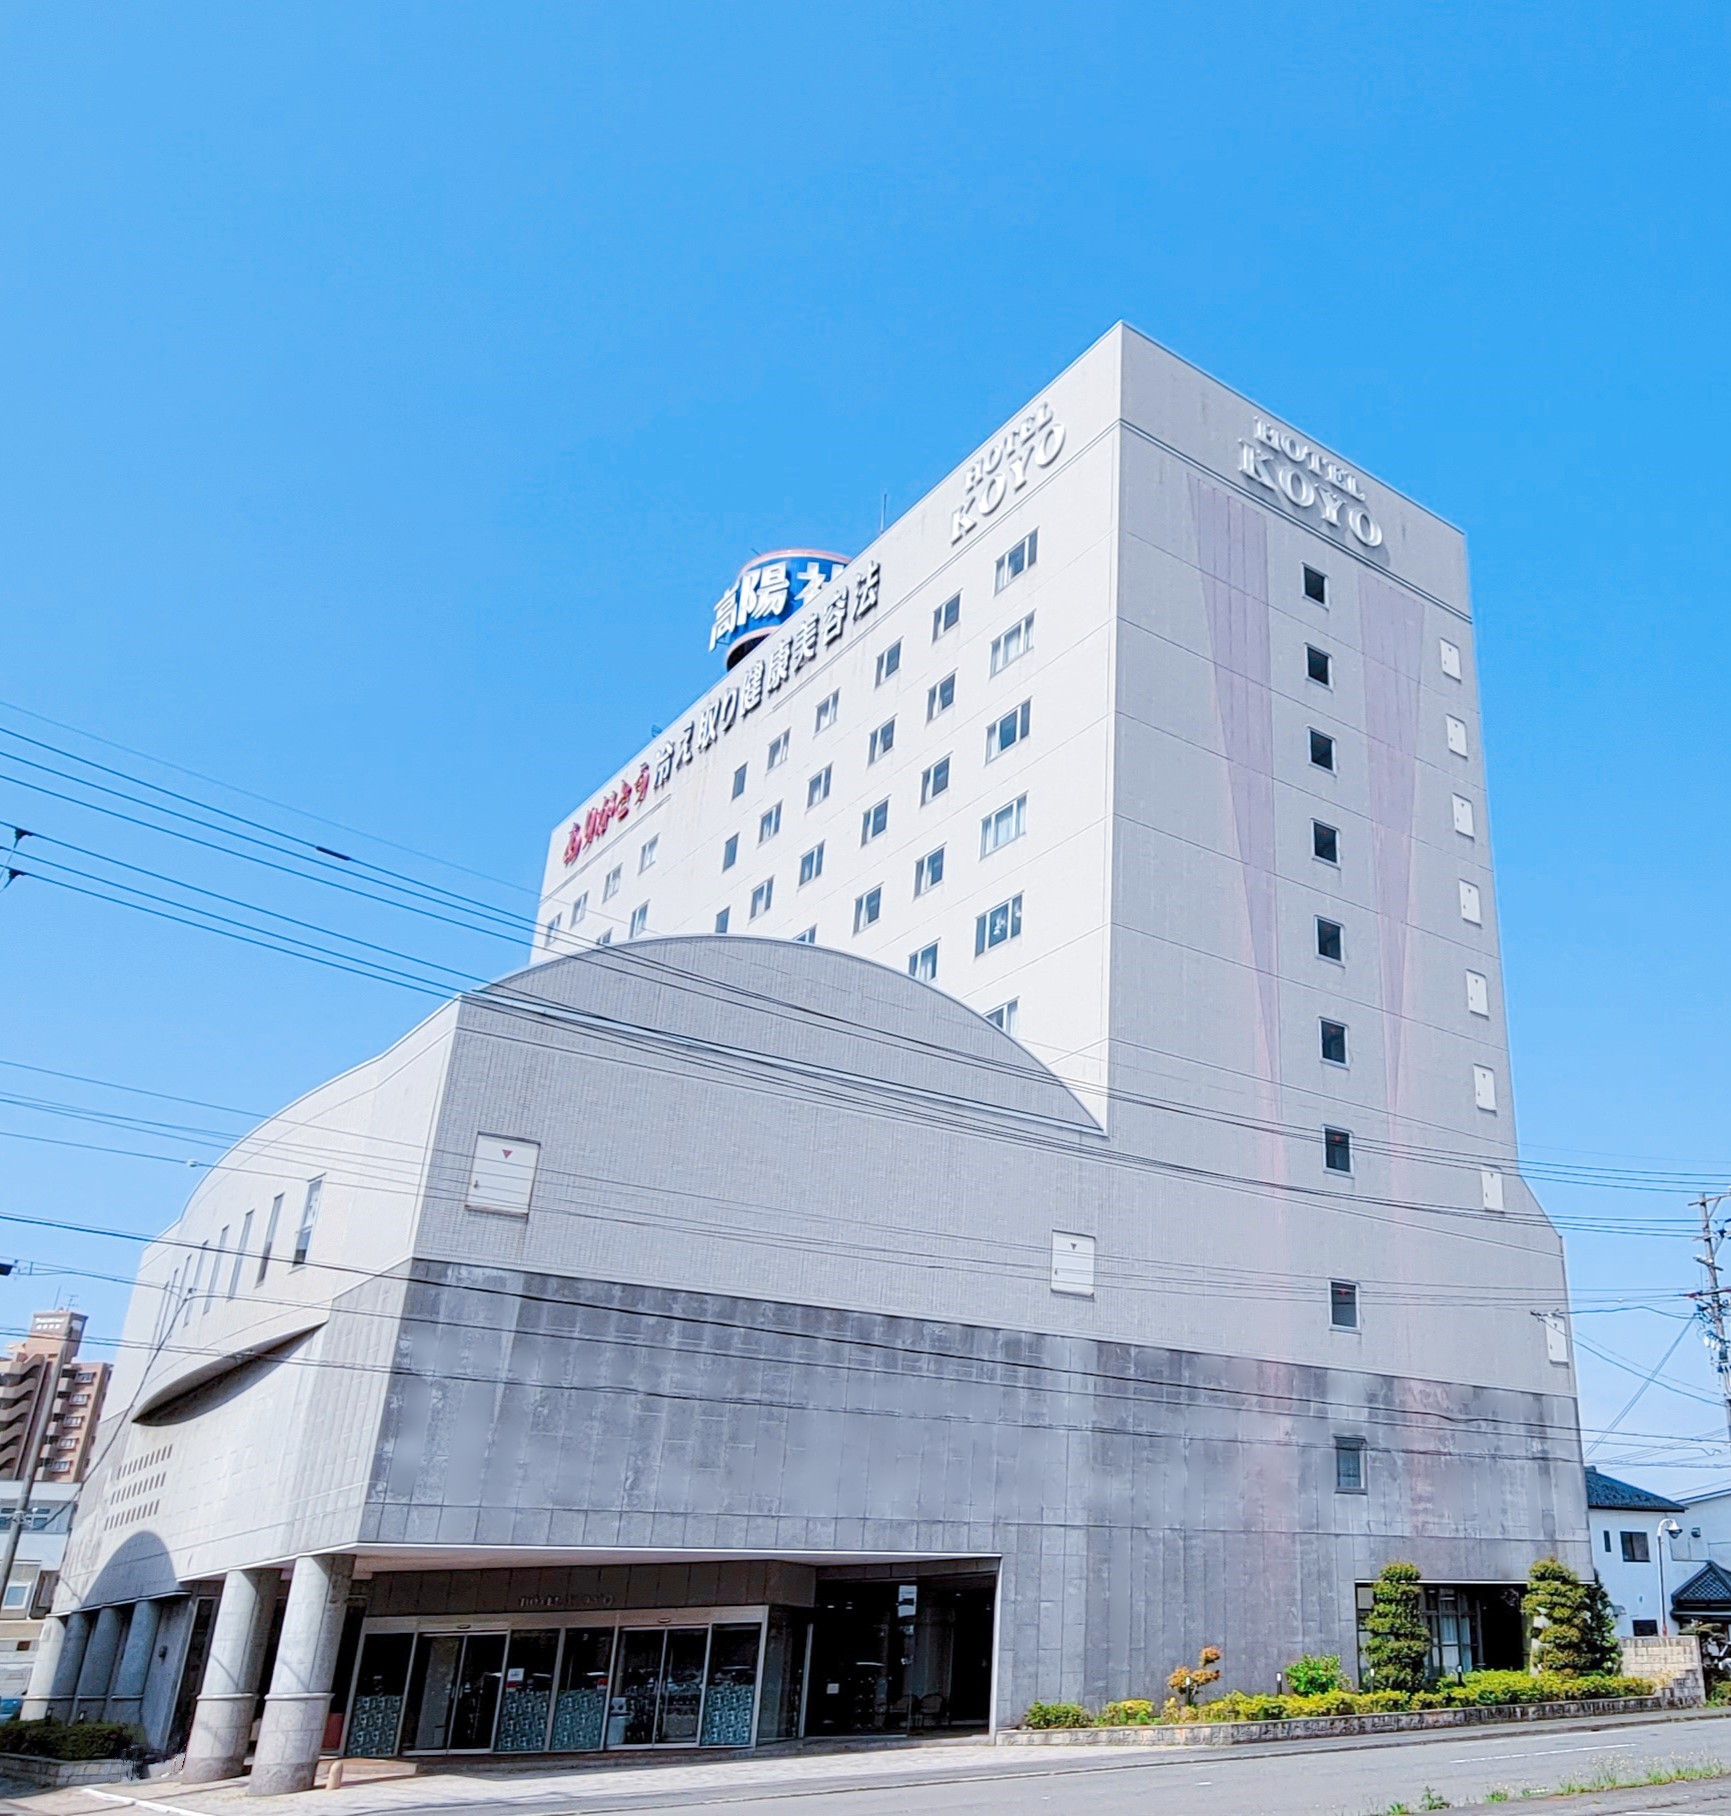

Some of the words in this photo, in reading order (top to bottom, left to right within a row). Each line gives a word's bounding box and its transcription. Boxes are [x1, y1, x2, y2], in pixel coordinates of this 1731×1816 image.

[951, 424, 1066, 547] KOYO
[966, 402, 1053, 493] HOTEL
[1238, 438, 1383, 547] KOYO
[1254, 416, 1365, 501] HOTEL
